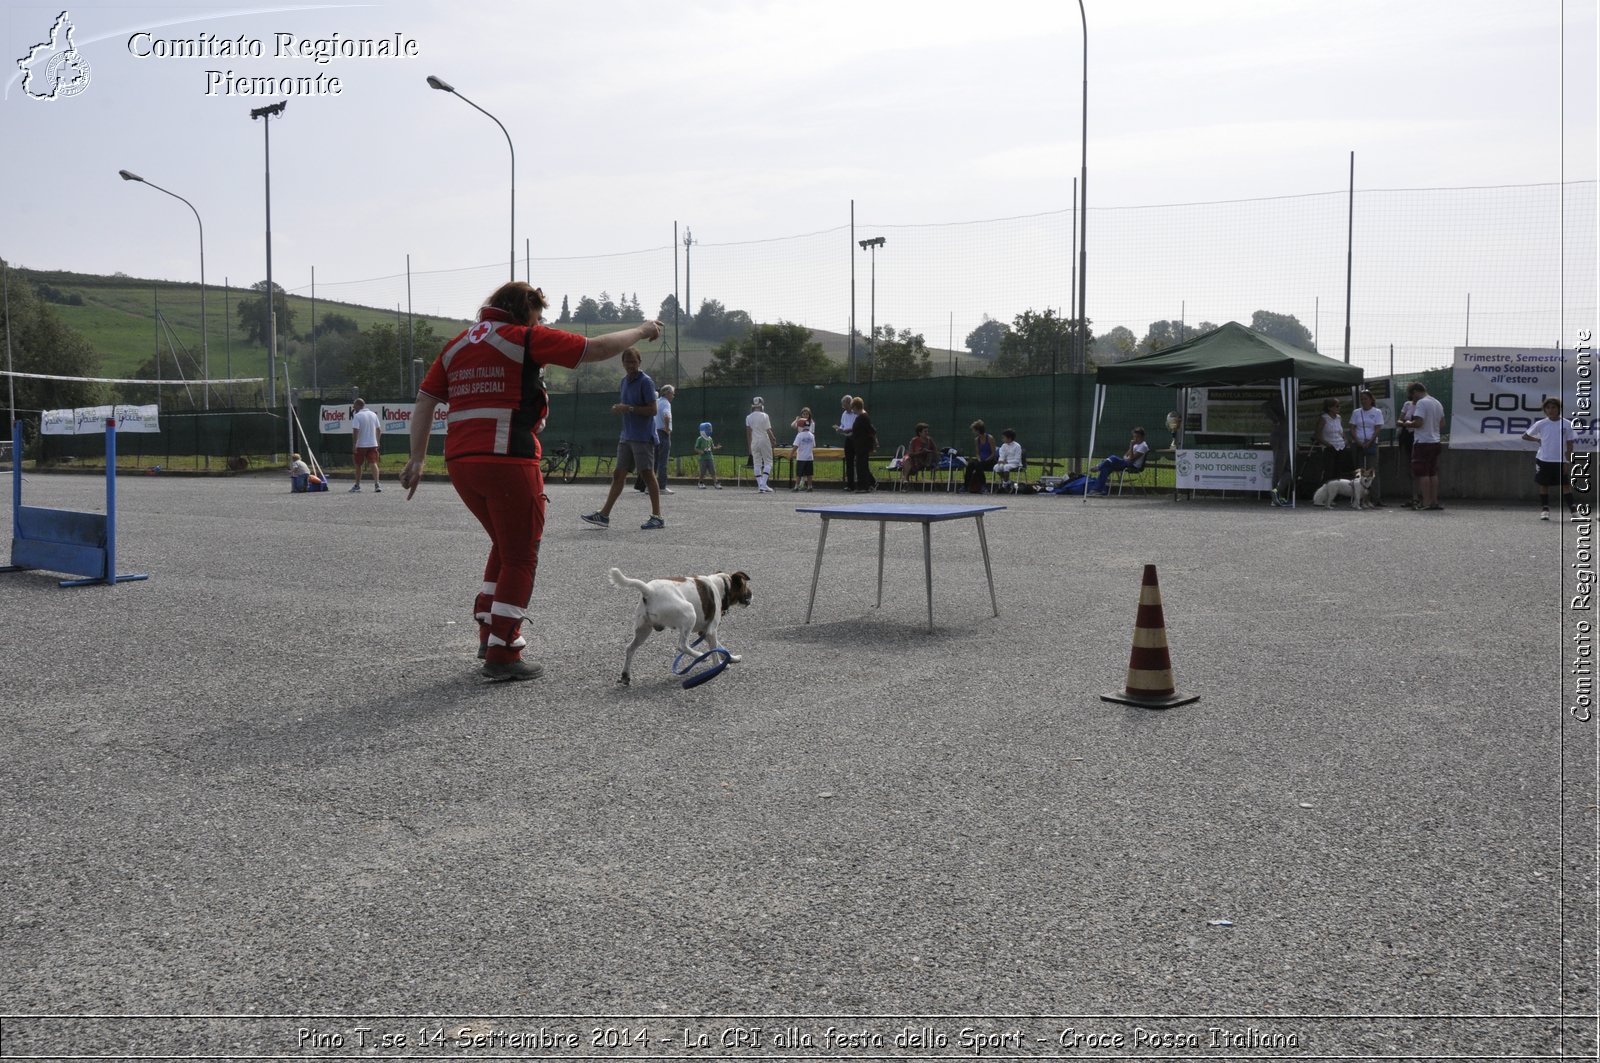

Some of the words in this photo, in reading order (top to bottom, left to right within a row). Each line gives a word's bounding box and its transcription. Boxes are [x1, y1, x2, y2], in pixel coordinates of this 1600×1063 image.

[1463, 353, 1514, 363] Trimestre,
[1516, 353, 1568, 364] Semestre,
[477, 366, 505, 378] ITALIANA
[1473, 364, 1501, 373] Anno
[1503, 363, 1556, 373] Scolastico
[1490, 374, 1539, 384] all'estero
[472, 381, 505, 394] SPECIALI
[1194, 451, 1227, 460] SCUOLA
[1228, 451, 1258, 460] CALCIO
[1194, 463, 1214, 471] PINO
[1216, 463, 1257, 472] TORINESE
